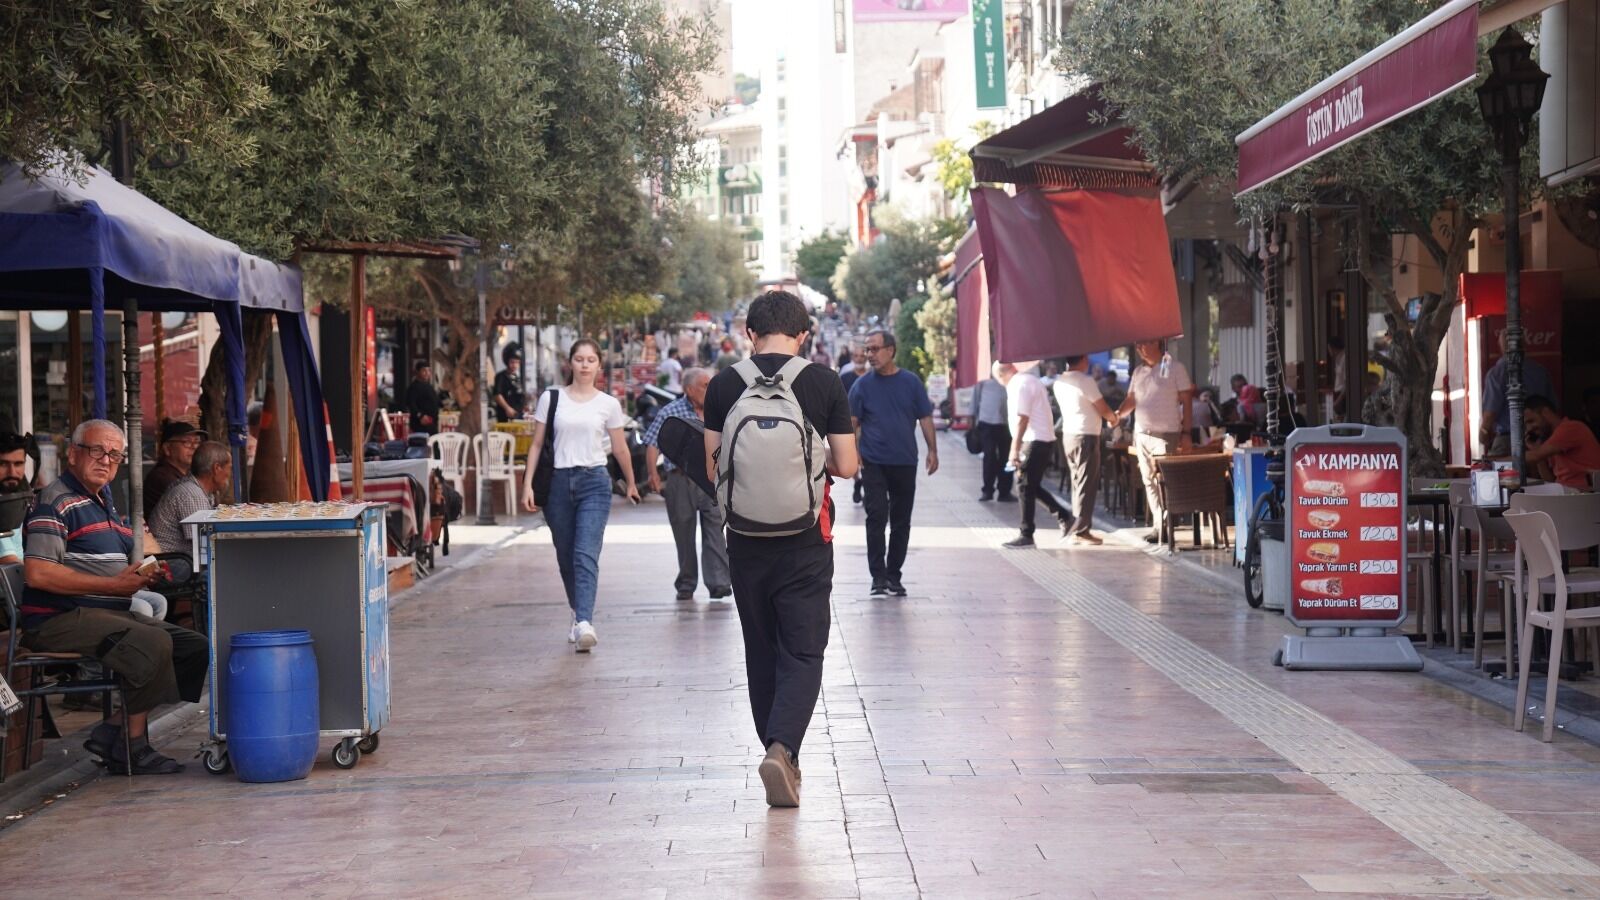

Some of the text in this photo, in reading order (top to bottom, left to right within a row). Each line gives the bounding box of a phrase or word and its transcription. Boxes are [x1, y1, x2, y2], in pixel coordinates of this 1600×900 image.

[1307, 85, 1364, 147] ÜSTÜN DÖNER
[1319, 453, 1399, 470] KAMPANYA
[1298, 496, 1321, 505] Tavuk
[1322, 495, 1349, 505] Dürüm
[1298, 530, 1321, 539] Tavuk
[1322, 529, 1348, 539] Ekmek
[1298, 562, 1324, 573] Yaprak
[1326, 562, 1348, 572] Yarım
[1349, 562, 1357, 572] Et
[1298, 598, 1324, 609] Yaprak
[1324, 597, 1349, 607] Dürüm
[1349, 598, 1357, 607] Et
